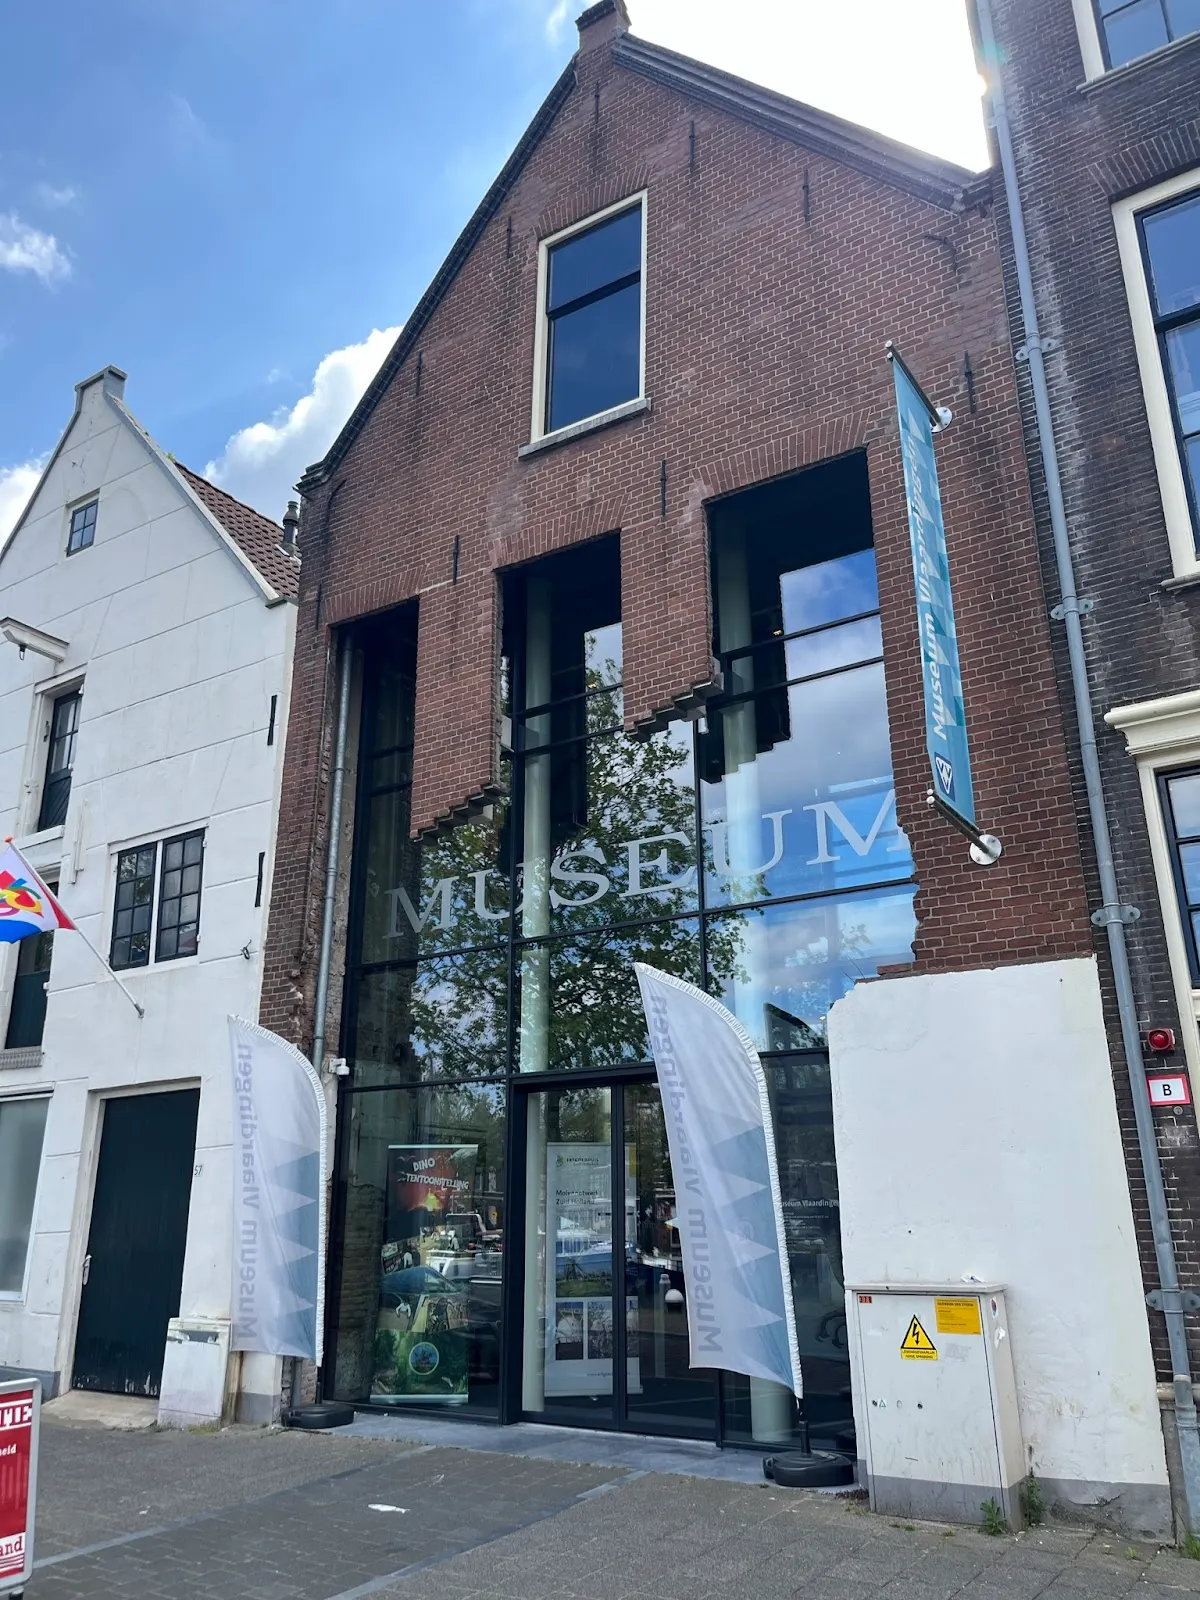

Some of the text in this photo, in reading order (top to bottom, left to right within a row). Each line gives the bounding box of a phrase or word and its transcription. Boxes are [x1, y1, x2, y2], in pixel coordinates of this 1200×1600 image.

[924, 612, 947, 741] Museum
[383, 787, 911, 940] MUSEUM
[1162, 1084, 1172, 1096] B
[412, 1157, 436, 1172] DINO
[0, 1405, 33, 1428] TIE
